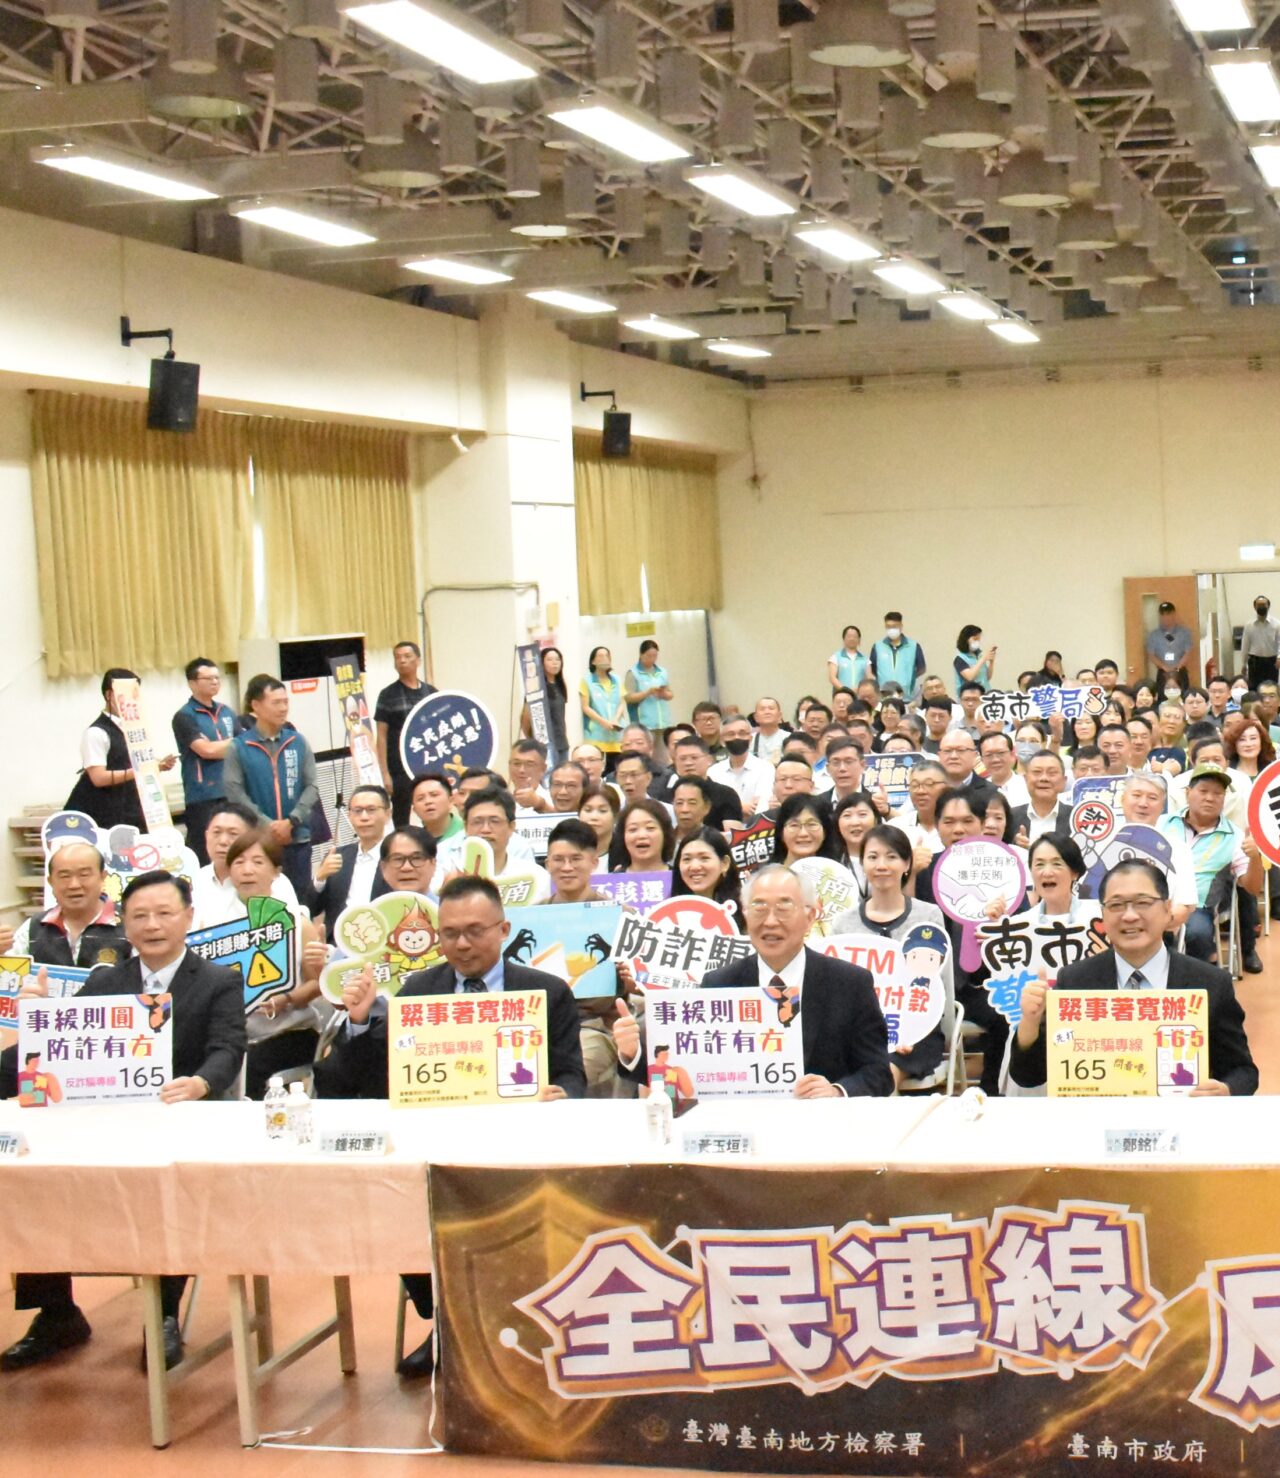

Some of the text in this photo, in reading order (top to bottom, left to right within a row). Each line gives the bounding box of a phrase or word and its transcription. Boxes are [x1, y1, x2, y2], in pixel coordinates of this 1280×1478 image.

[981, 685, 1083, 720] 南市警局
[971, 856, 1017, 867] 與民有約
[980, 917, 1086, 972] 南市
[400, 995, 542, 1028] 緊事著寬辦!!
[653, 999, 763, 1025] 事緩則圓
[874, 985, 930, 1013] 付款
[1058, 993, 1204, 1022] 緊事著寬辦!!
[26, 1006, 134, 1034] 事緩則圓
[47, 1033, 155, 1062] 防詐有方
[414, 1040, 485, 1057] 反詐騙專線
[492, 1029, 543, 1049] 165
[675, 1027, 785, 1055] 防詐有方
[1072, 1038, 1144, 1053] 反詐騙專線
[1152, 1029, 1205, 1048] 165
[119, 1066, 165, 1088] 165
[402, 1062, 448, 1084] 165
[750, 1061, 797, 1084] 165
[1060, 1058, 1107, 1081] 165
[541, 1214, 1148, 1380] 全民連線
[682, 1418, 926, 1457] 臺灣臺南地方檢察署
[1066, 1432, 1208, 1464] 臺南市政府
